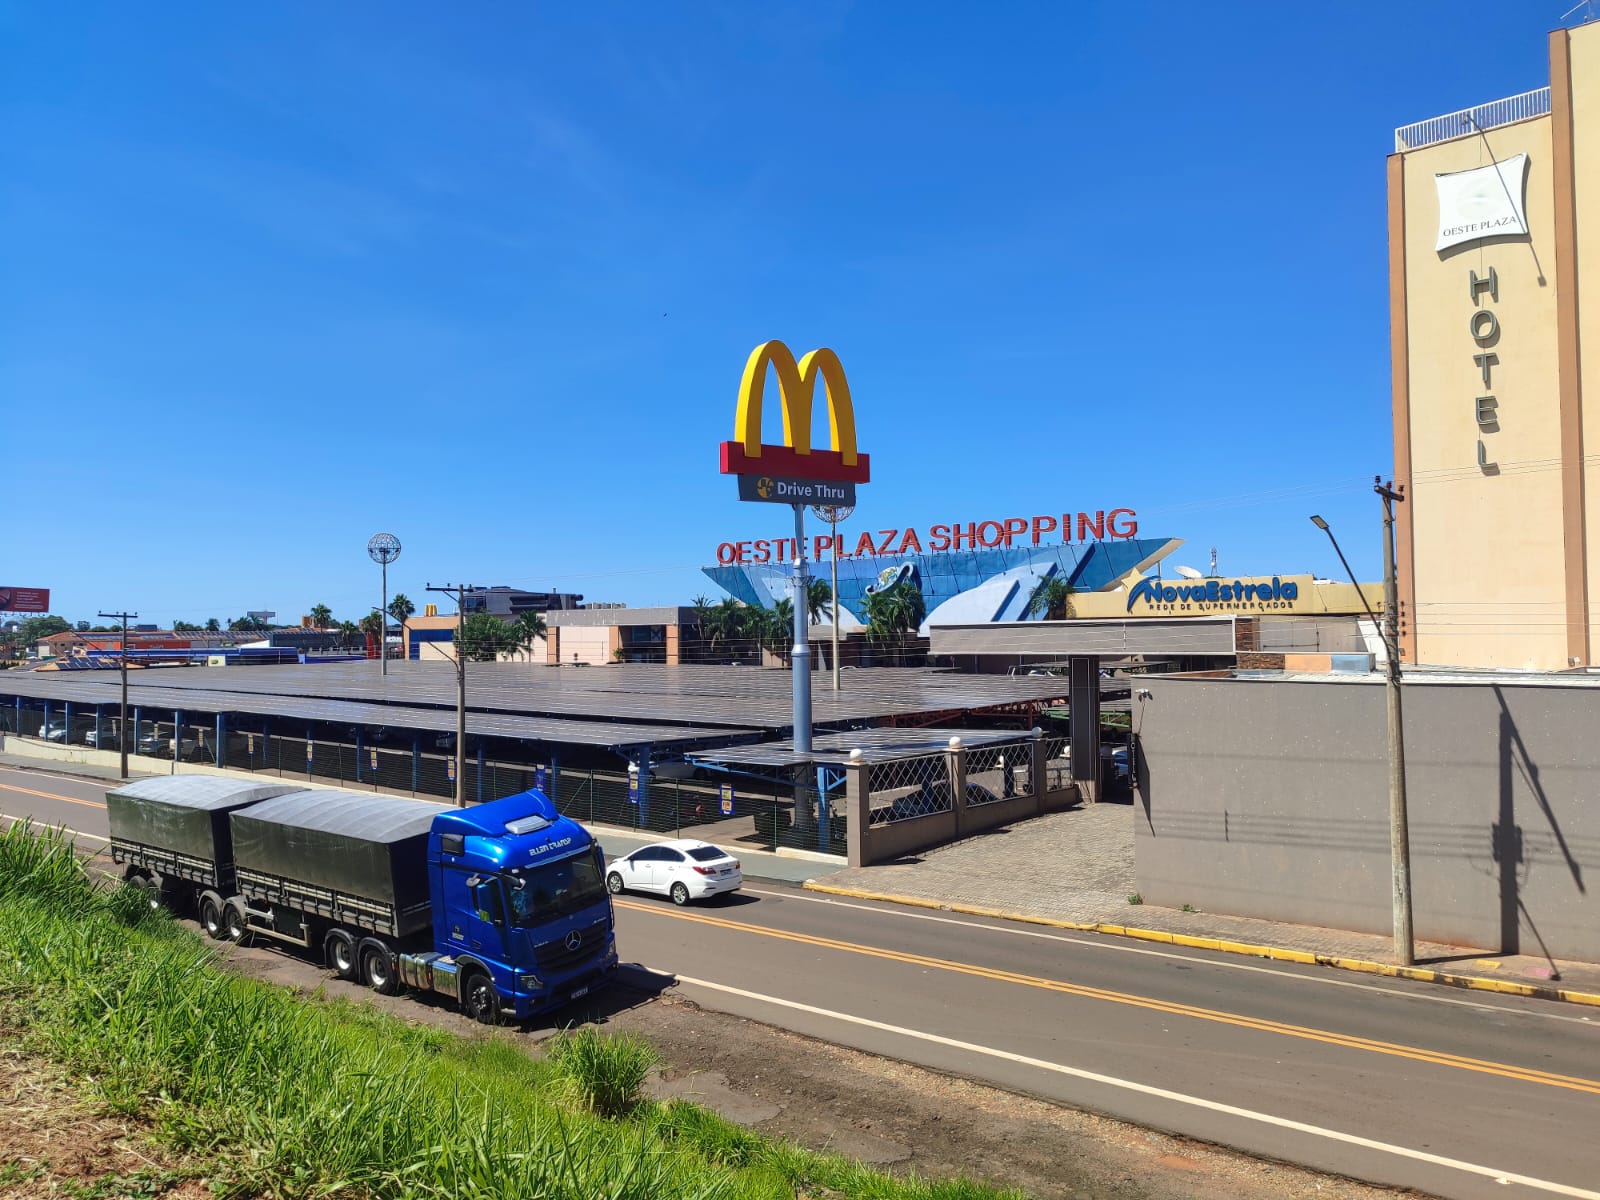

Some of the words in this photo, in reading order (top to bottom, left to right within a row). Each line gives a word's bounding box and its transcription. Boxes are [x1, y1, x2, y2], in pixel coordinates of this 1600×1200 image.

[1443, 223, 1478, 237] OESTE
[1480, 215, 1518, 230] PLAZA
[1469, 266, 1499, 470] HOTEL
[777, 482, 813, 496] Drive
[814, 484, 845, 499] Thru
[716, 536, 808, 565] OESTE
[814, 527, 922, 560] PLAZA
[929, 508, 1139, 552] SHOPPING
[1149, 603, 1175, 611] REDE
[1180, 603, 1191, 611] DE
[1198, 602, 1293, 612] SUPERMERCADOS
